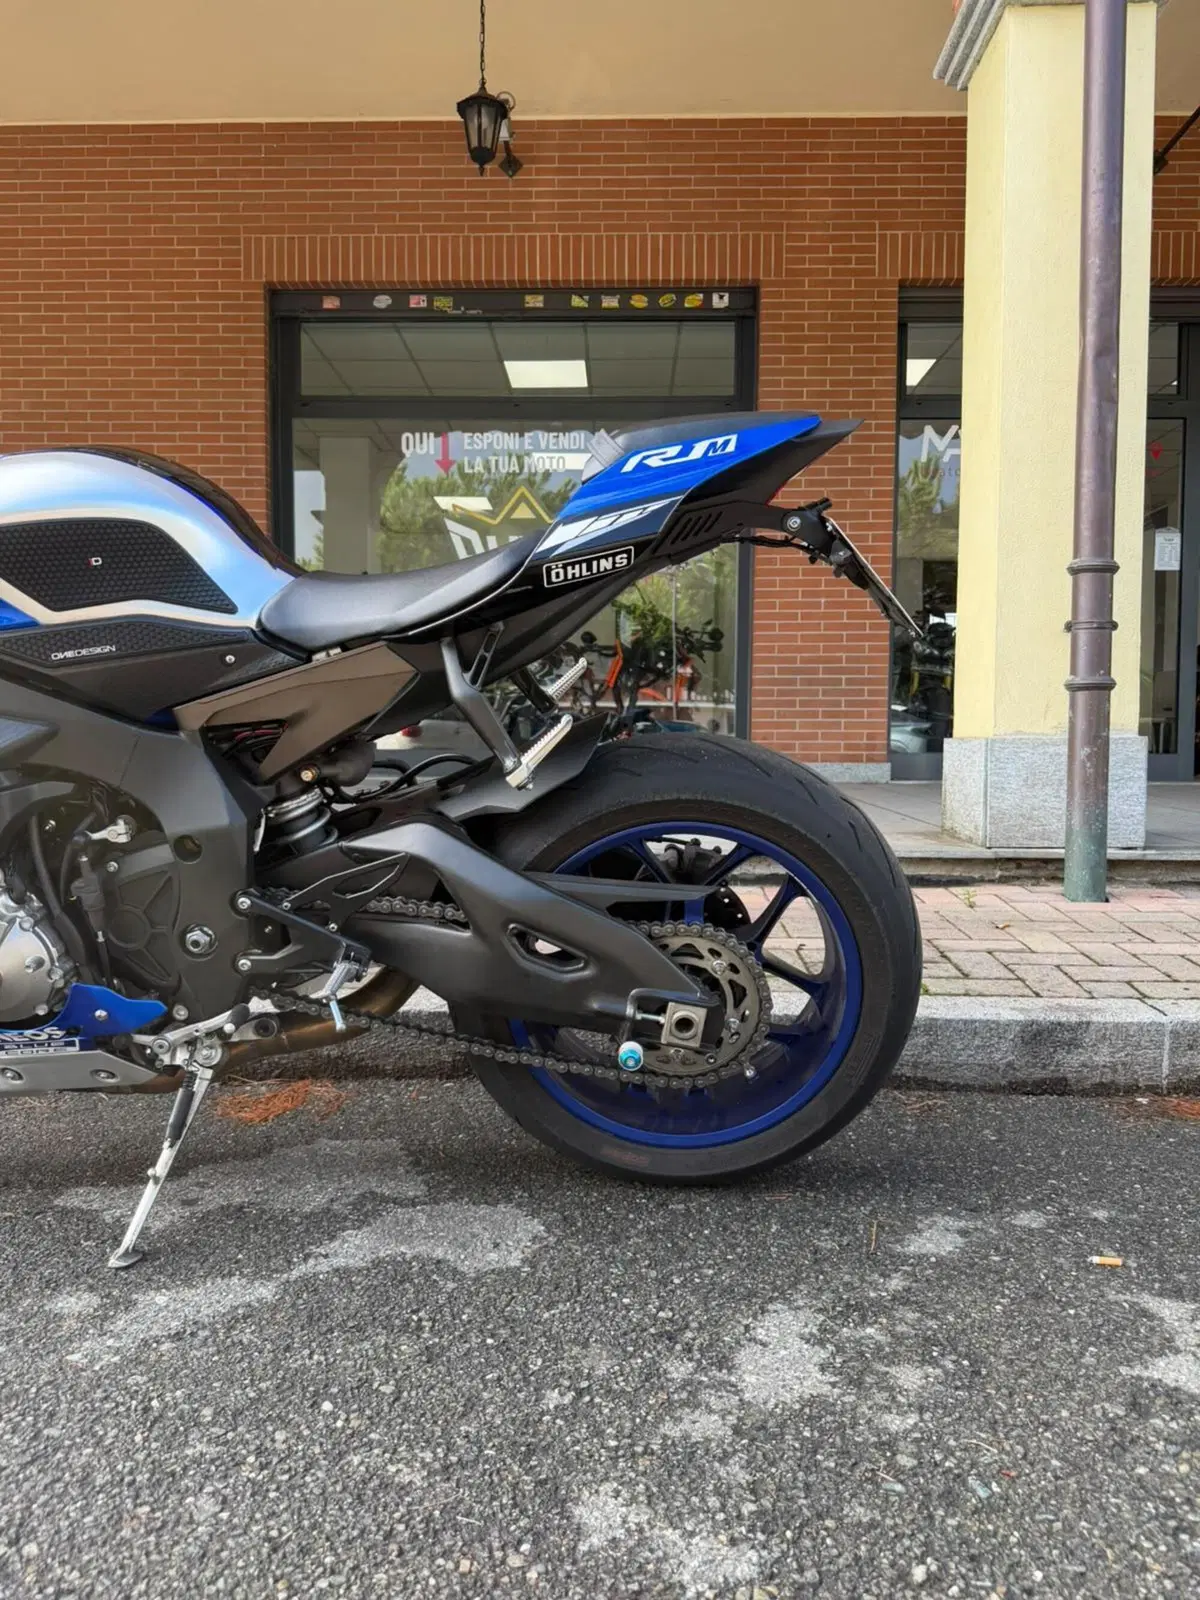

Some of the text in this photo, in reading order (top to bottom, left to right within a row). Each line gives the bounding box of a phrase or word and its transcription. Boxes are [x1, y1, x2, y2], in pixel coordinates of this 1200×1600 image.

[401, 432, 435, 456] QUI
[464, 432, 585, 450] ESPONI E VENDI
[464, 456, 566, 473] LA TUA MOTO
[551, 553, 629, 583] ÖHLINS
[51, 645, 116, 660] ONEDESIGN
